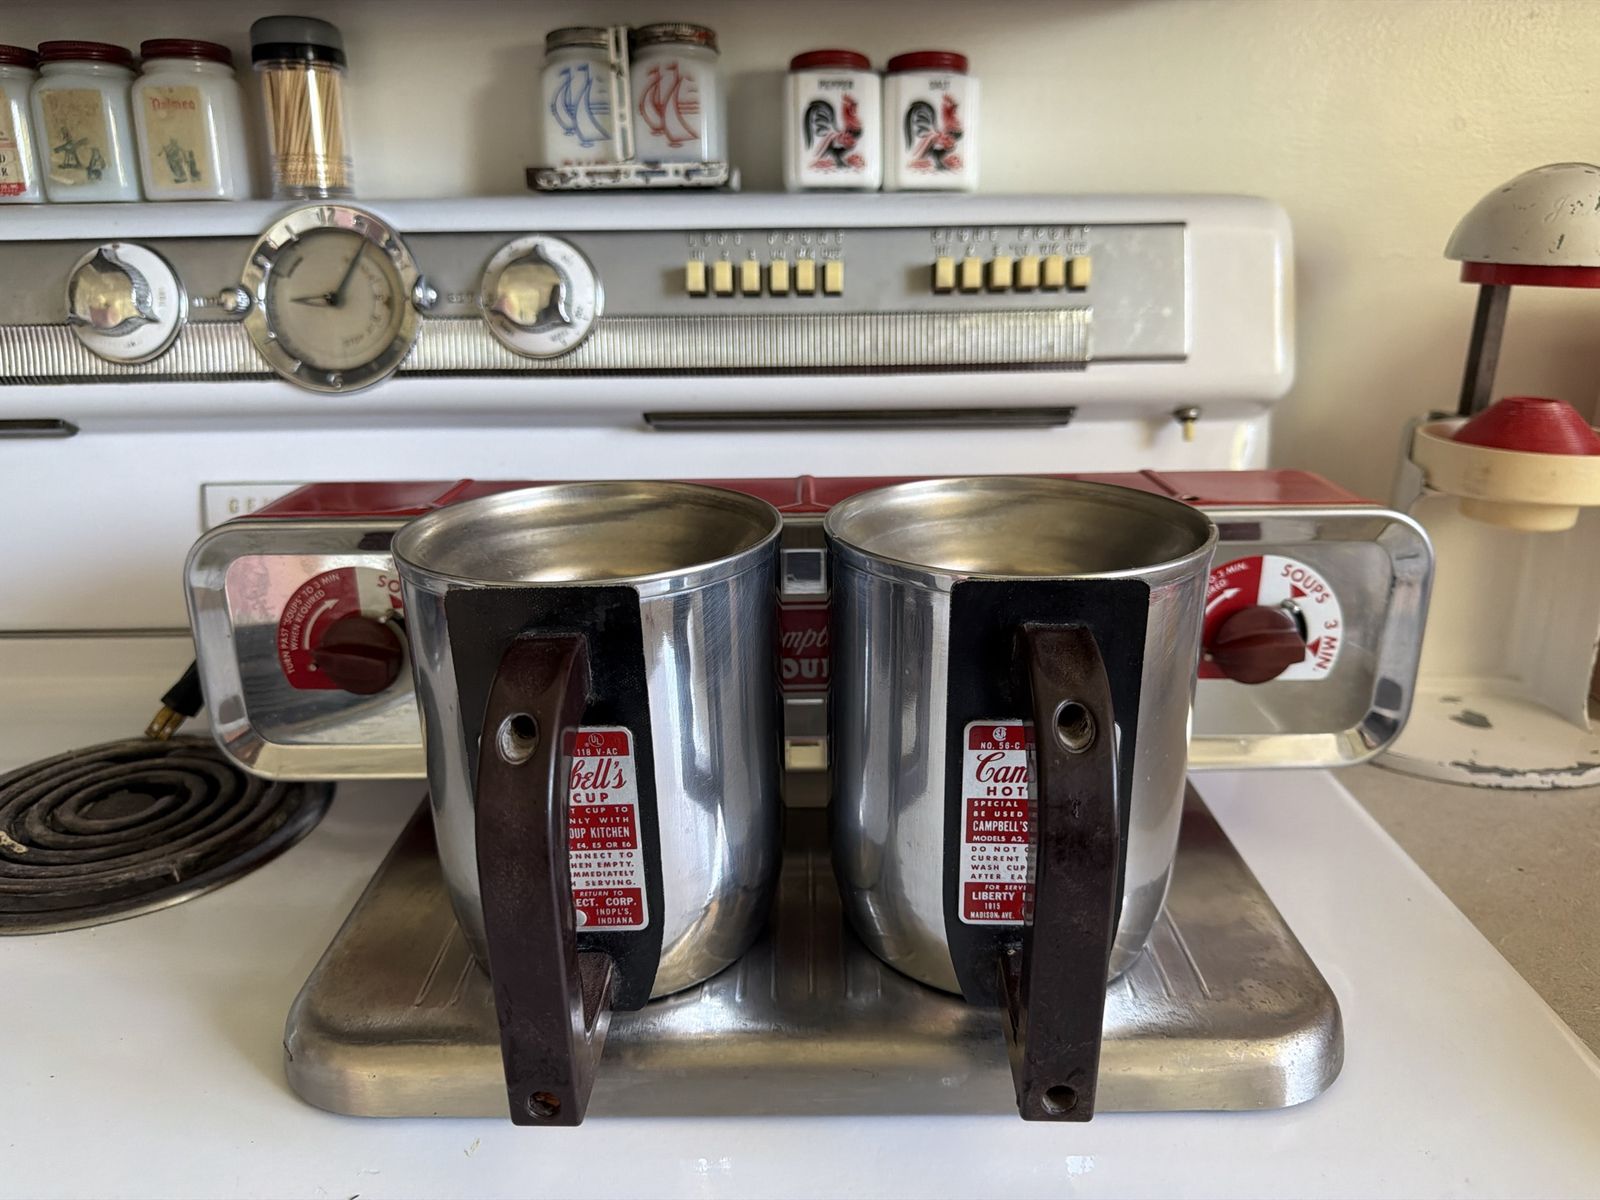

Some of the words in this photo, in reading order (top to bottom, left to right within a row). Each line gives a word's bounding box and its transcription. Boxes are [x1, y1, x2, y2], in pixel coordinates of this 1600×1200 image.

[1281, 564, 1330, 604] SOUPS
[303, 586, 315, 597] TO
[290, 623, 301, 651] WHEN
[296, 589, 326, 625] REQUIRED
[1324, 619, 1338, 630] 3
[280, 628, 290, 650] PAST
[283, 651, 295, 674] TURN
[986, 786, 1024, 796] HOT
[573, 793, 609, 803] CUP
[994, 810, 1024, 818] USED
[973, 820, 1029, 832] CAMPBELL'S
[590, 826, 630, 839] KITCHEN
[585, 879, 636, 887] SERVING.
[605, 897, 637, 906] CORP.
[972, 891, 1015, 901] LIBERTY
[598, 916, 634, 925] INDIANA
